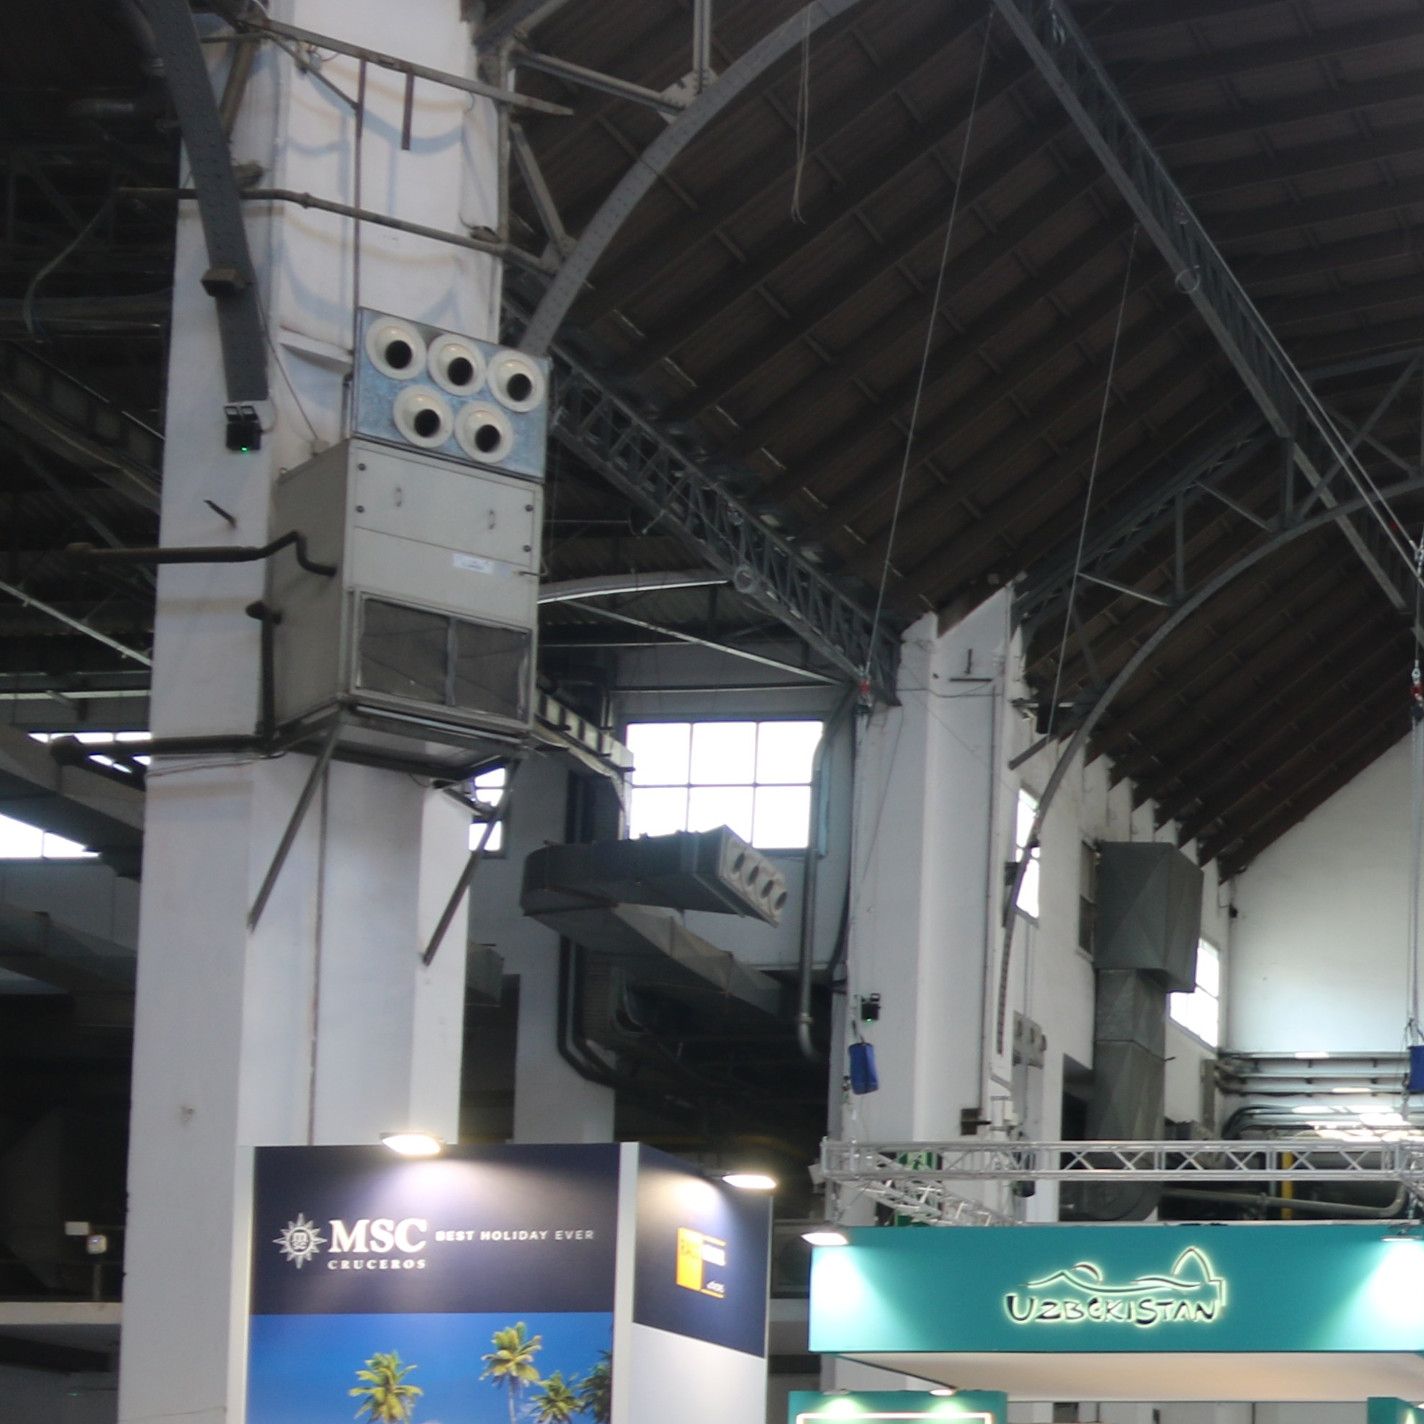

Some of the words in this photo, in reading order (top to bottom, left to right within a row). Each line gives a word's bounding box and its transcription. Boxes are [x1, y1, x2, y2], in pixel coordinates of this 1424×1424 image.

[328, 1218, 428, 1254] MSC
[435, 1230, 474, 1242] BEST
[480, 1229, 548, 1241] HOLIDAY
[554, 1229, 595, 1240] EVER
[327, 1258, 427, 1270] CRUCEROS
[1005, 1294, 1218, 1328] UZBEKISTAN
